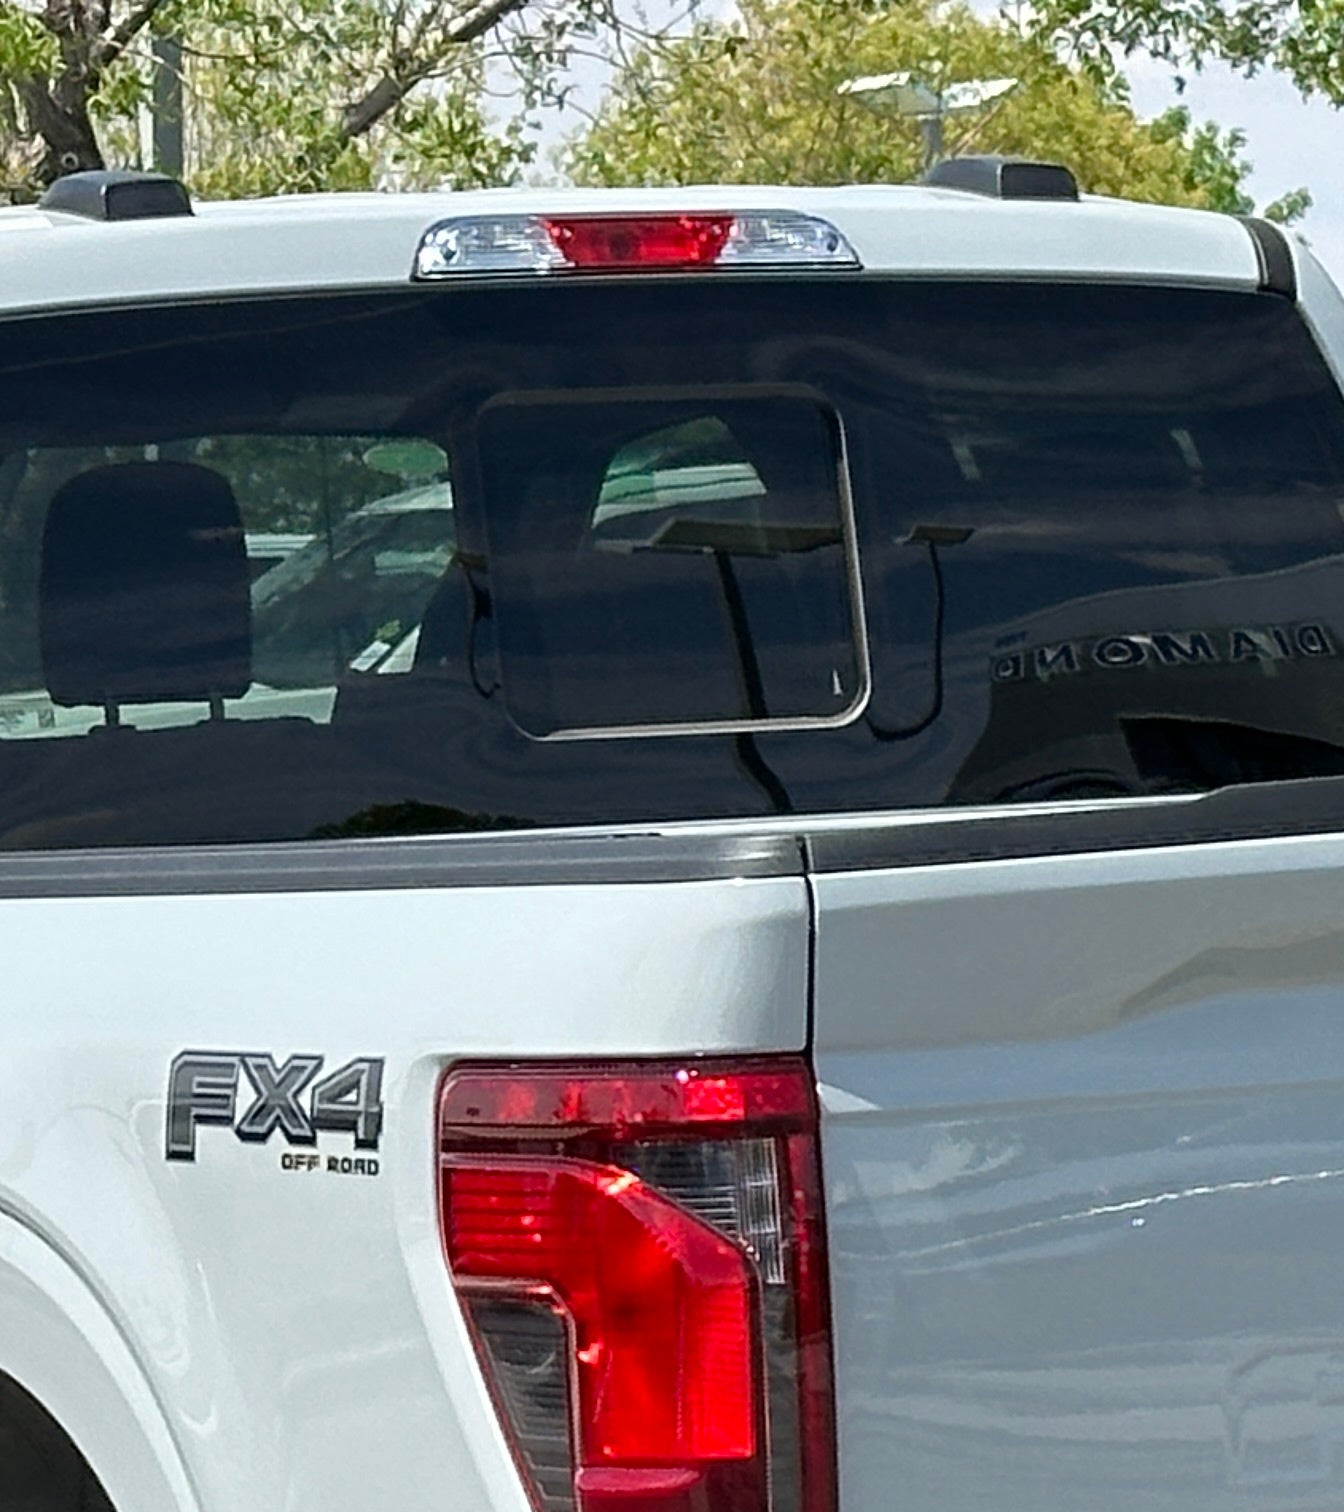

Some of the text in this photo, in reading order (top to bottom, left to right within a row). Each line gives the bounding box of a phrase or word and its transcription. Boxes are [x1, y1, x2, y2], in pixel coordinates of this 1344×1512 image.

[165, 1049, 386, 1161] FX4
[280, 1153, 380, 1177] OFF ROAD
